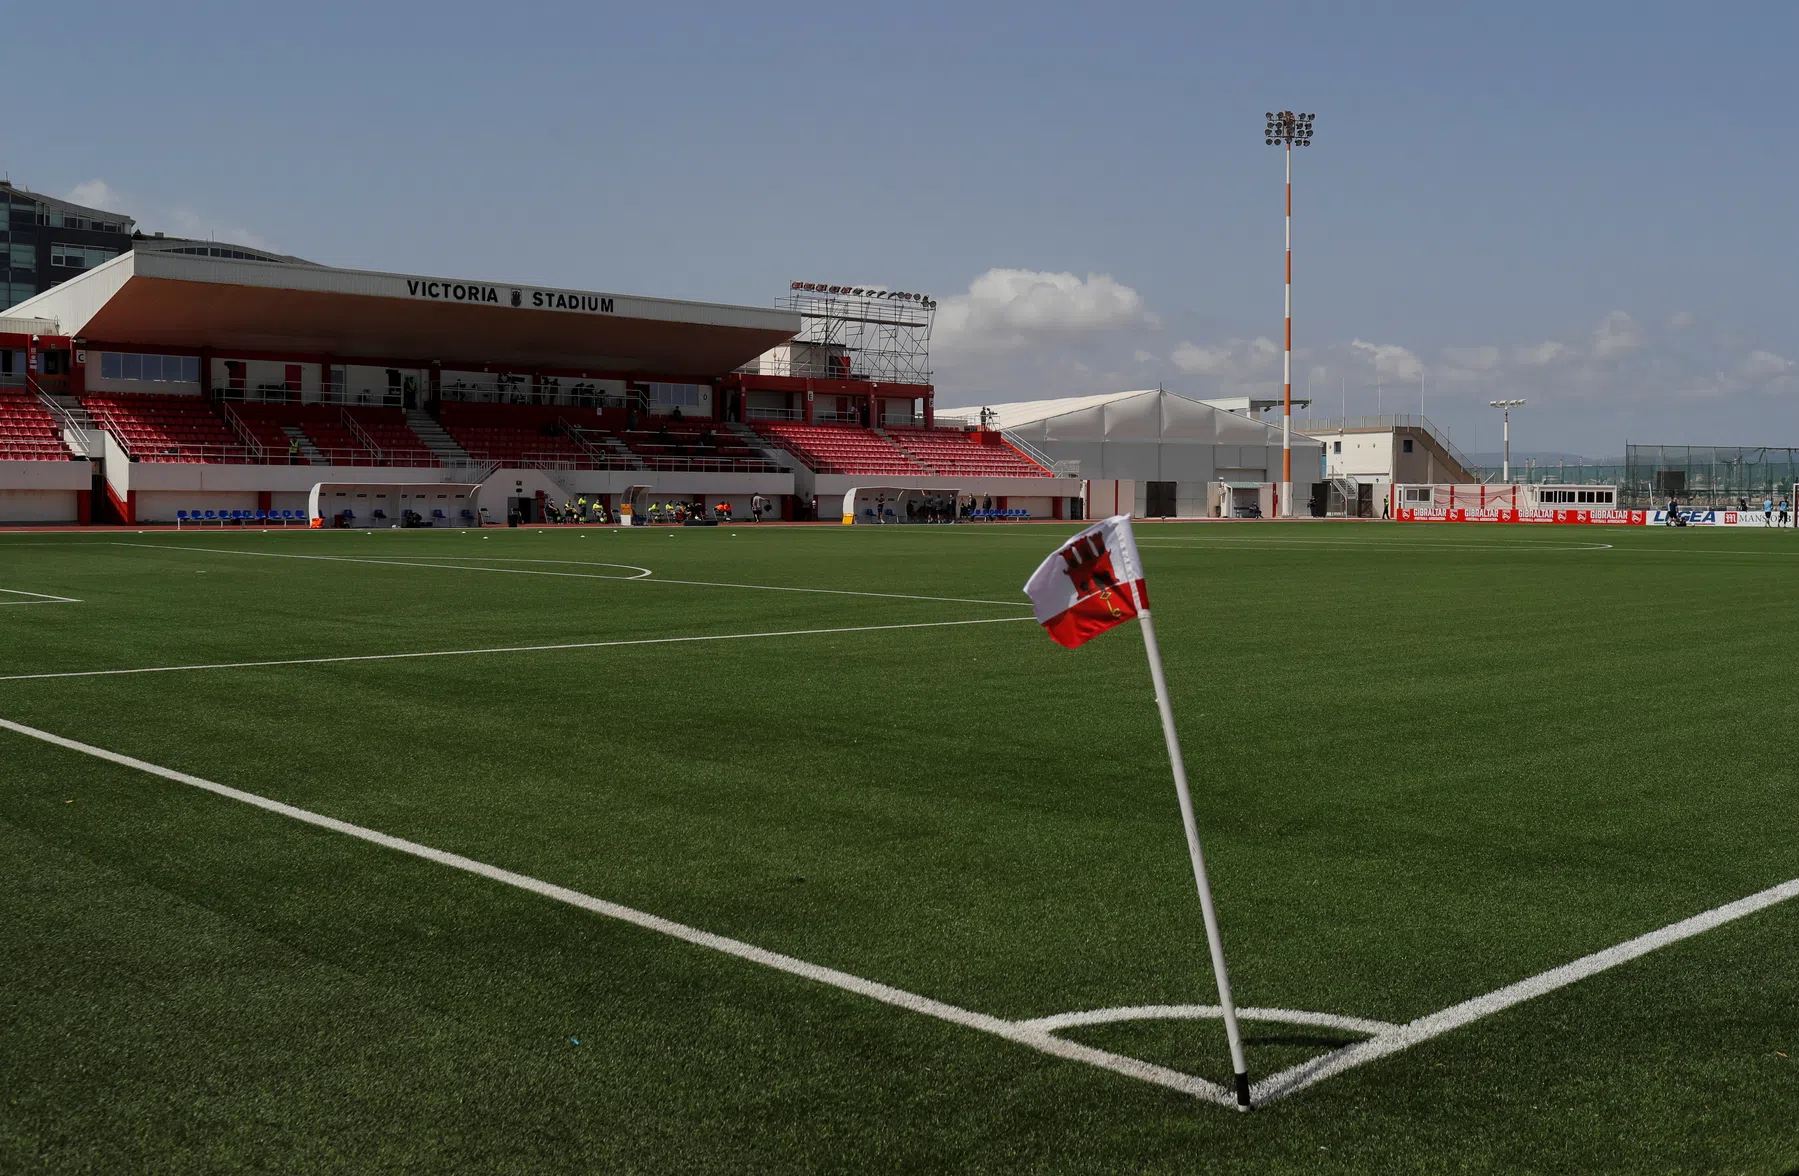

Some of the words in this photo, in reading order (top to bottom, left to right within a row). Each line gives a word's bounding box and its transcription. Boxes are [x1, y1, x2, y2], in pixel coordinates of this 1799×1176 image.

[407, 281, 498, 302] VICTORIA
[533, 292, 613, 312] STADIUM
[1413, 508, 1446, 517] GIBRALTAR
[1464, 508, 1499, 517] GIBRALTAR
[1518, 509, 1554, 518] GIBRALTAR
[1590, 510, 1628, 519] GIBRALTAR
[1654, 511, 1715, 522] LGEA
